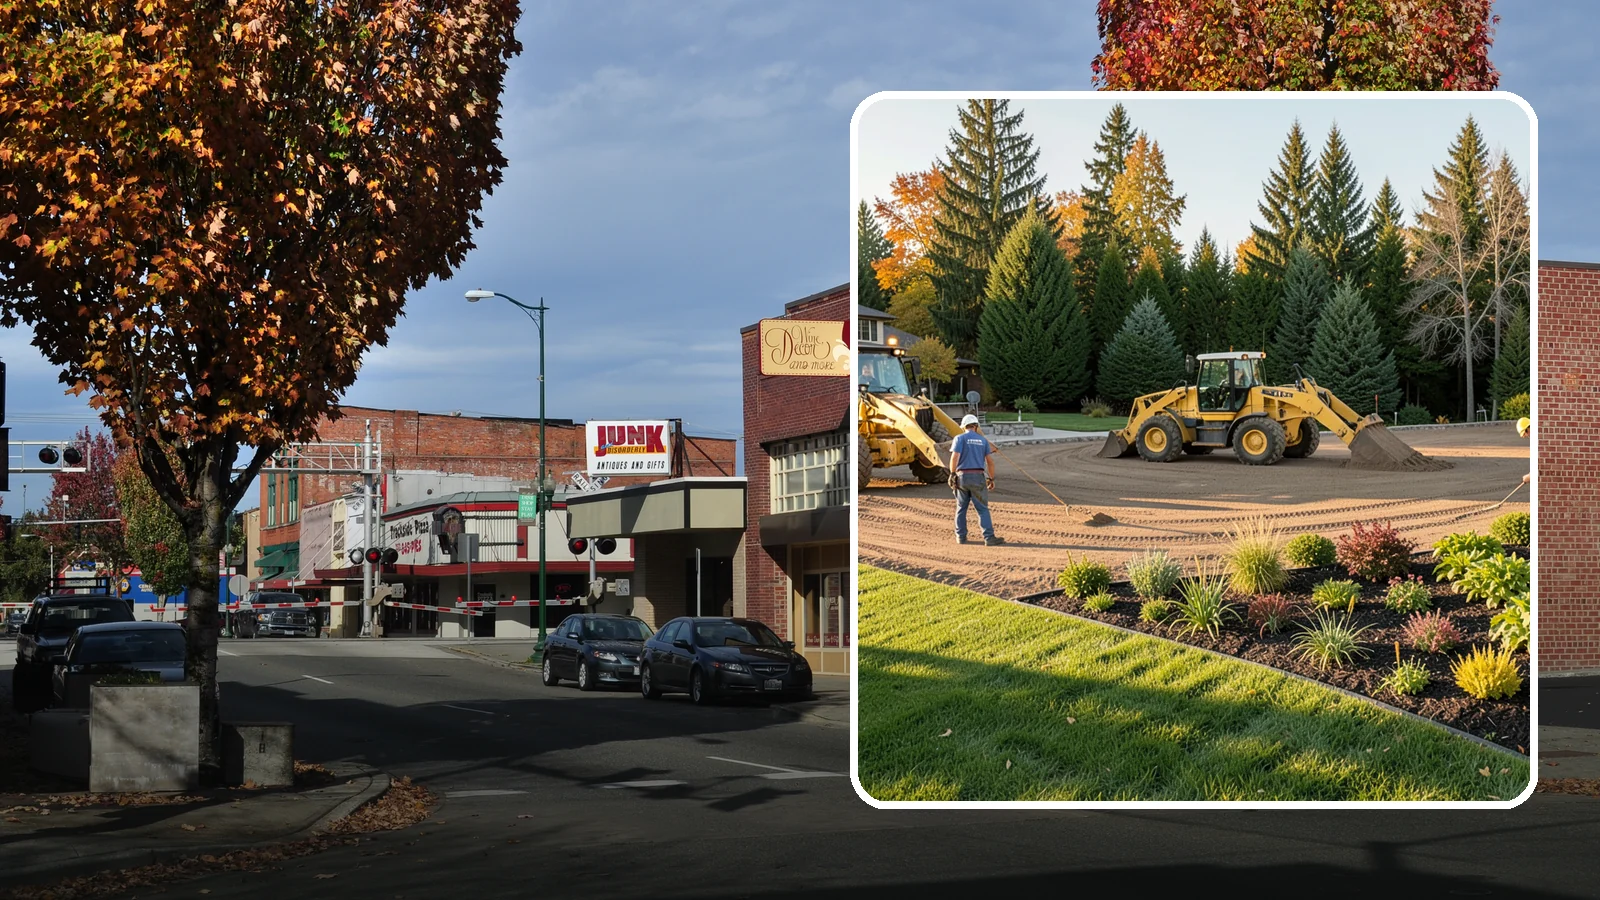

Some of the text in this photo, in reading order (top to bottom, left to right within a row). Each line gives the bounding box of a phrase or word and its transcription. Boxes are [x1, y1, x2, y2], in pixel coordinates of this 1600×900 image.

[765, 327, 831, 365] Decor
[595, 425, 665, 457] JUNK
[607, 446, 646, 454] DISORDERLY
[597, 460, 666, 470] ANTIQUES AND GIFTS
[414, 519, 429, 535] Pizza
